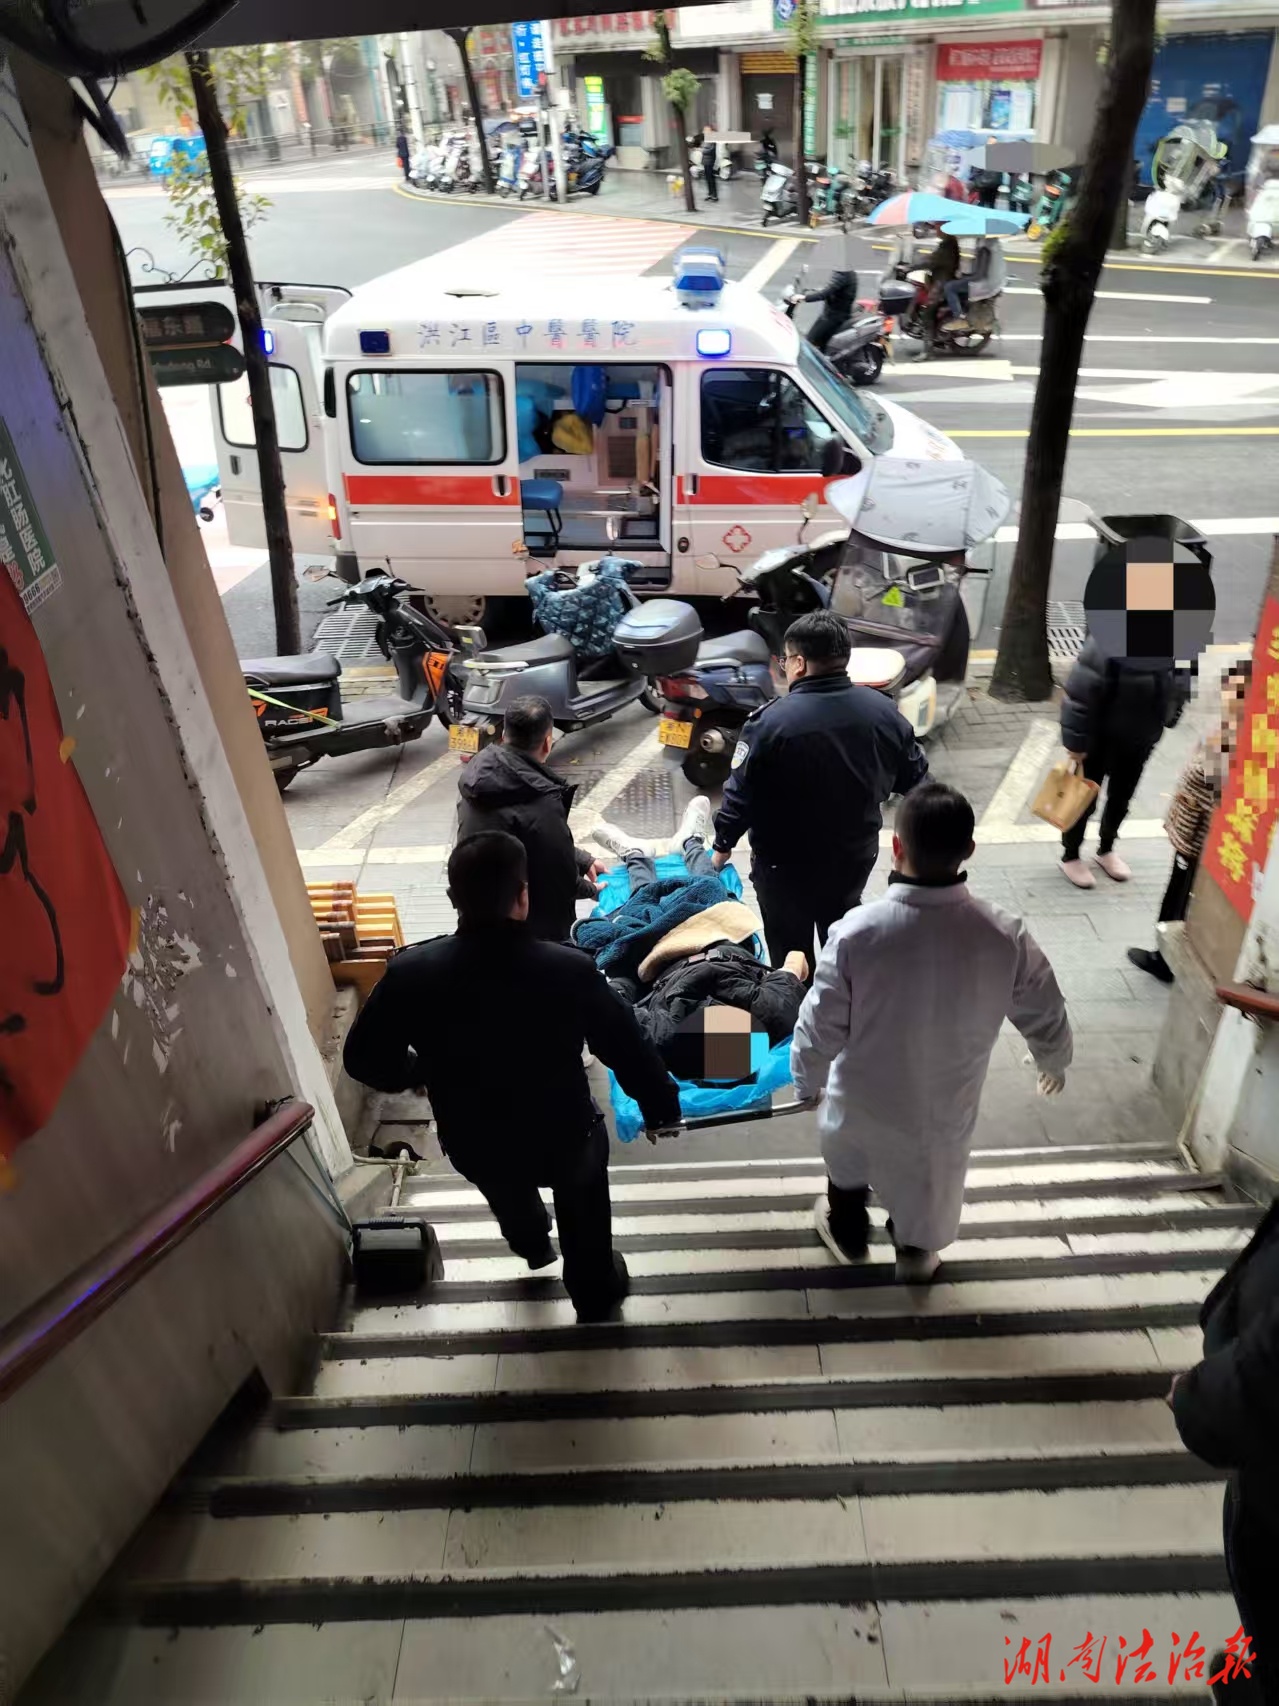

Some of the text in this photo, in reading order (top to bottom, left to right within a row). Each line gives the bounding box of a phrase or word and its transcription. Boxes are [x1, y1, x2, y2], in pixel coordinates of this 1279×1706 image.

[417, 318, 637, 349] 洪江區中醫醫院
